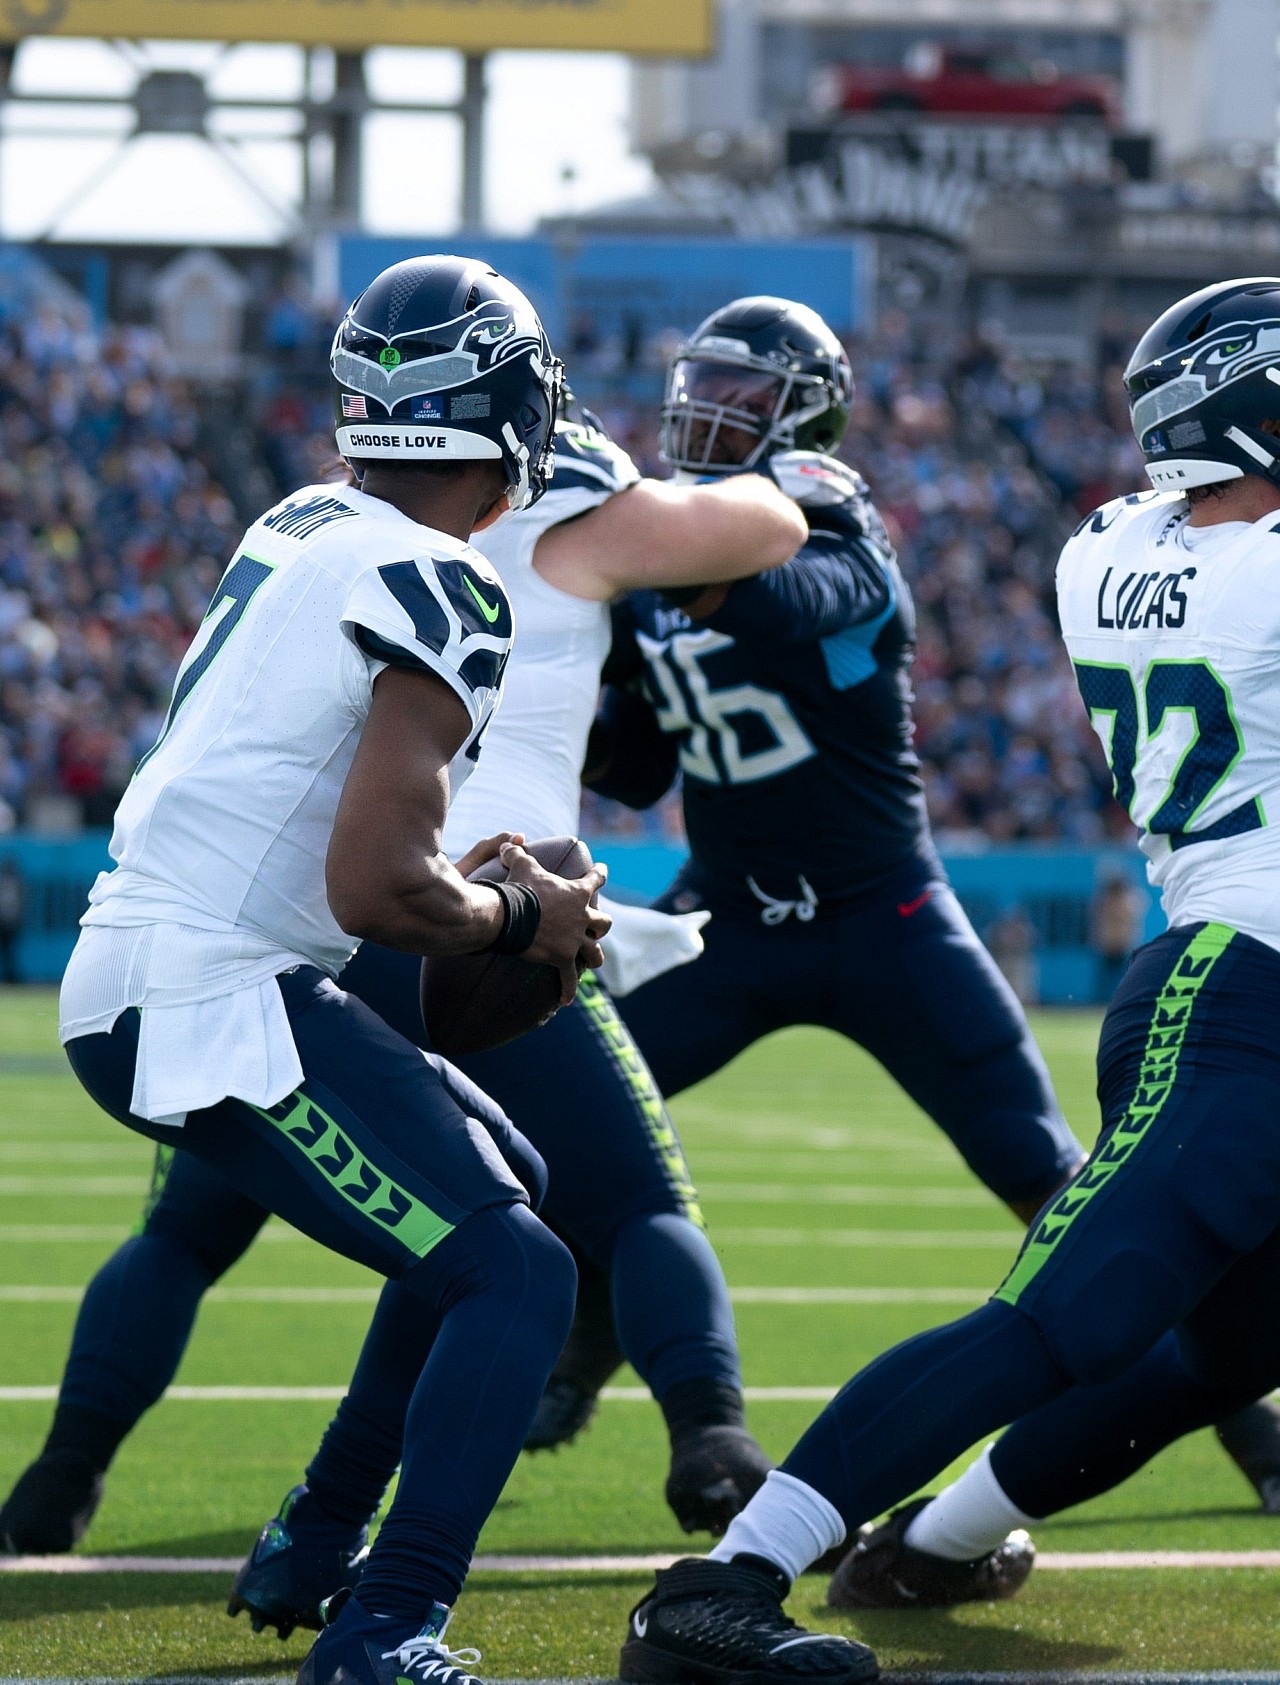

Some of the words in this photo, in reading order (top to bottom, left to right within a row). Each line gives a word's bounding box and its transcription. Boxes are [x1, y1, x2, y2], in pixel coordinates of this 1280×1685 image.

[350, 434, 400, 447] CHOOSE
[405, 435, 447, 448] LOVE
[262, 495, 361, 541] SMITH
[1097, 566, 1198, 630] LUCAS
[131, 550, 279, 782] 7
[1072, 656, 1269, 854] 72
